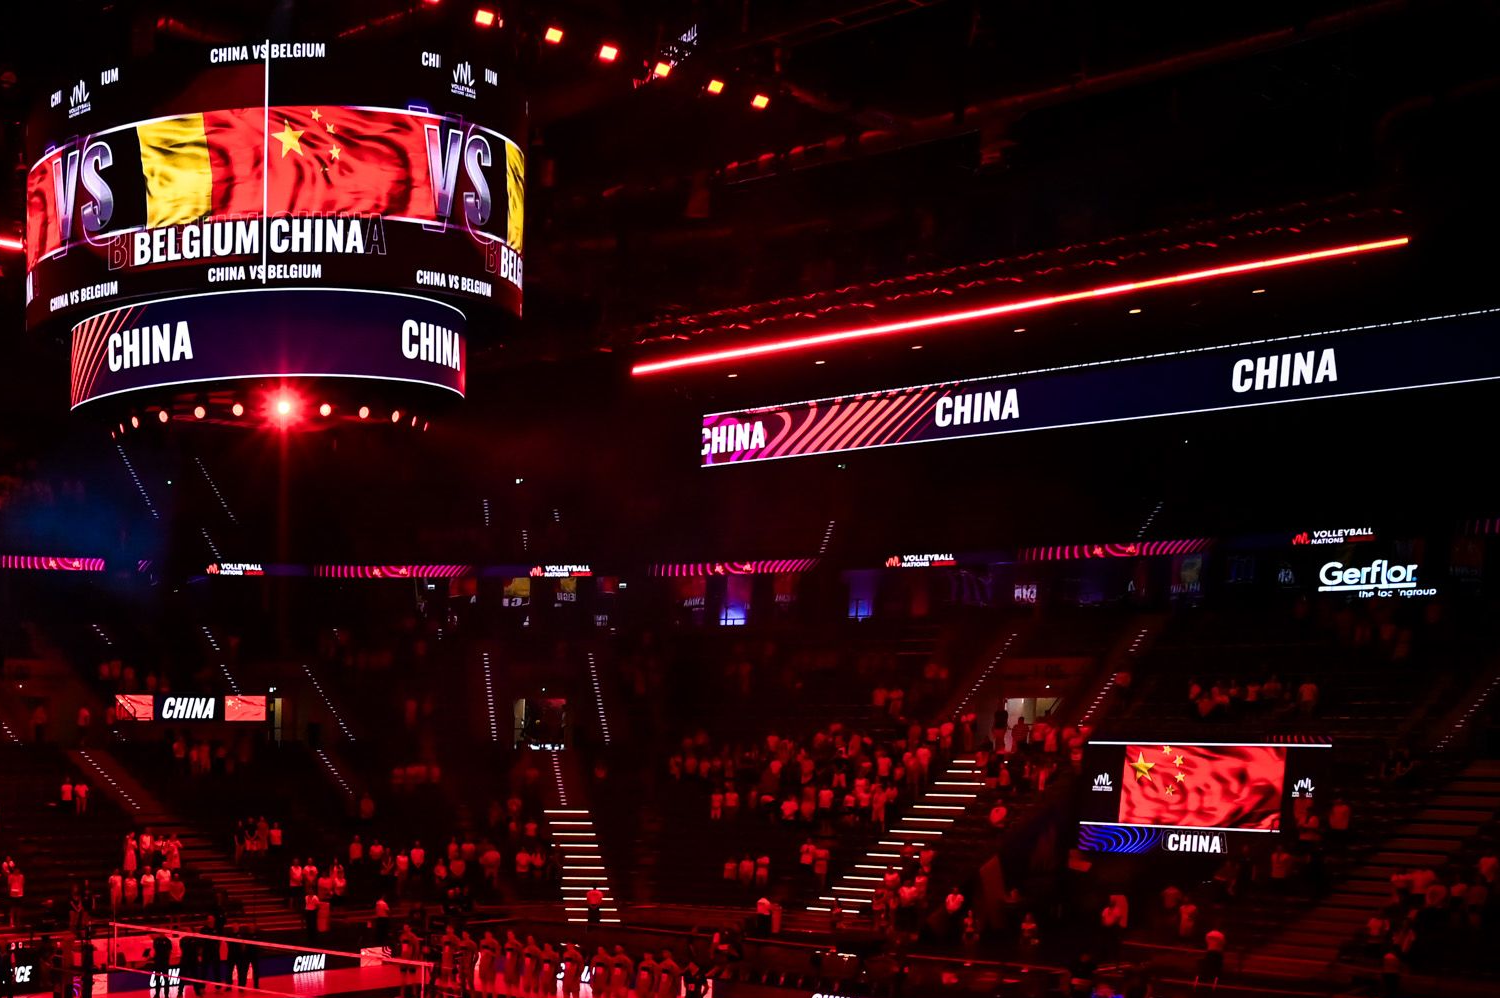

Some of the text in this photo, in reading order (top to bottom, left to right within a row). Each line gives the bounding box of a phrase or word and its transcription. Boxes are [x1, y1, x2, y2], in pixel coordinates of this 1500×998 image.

[209, 43, 326, 63] CHINA VS BELGIUM
[101, 67, 119, 86] IUM
[453, 61, 475, 87] VNL
[69, 79, 90, 107] VNL
[424, 124, 492, 226] VS
[52, 141, 114, 240] VS
[134, 218, 365, 266] BELGIUM CHINA
[208, 264, 322, 283] CHINA VS BELGIUM
[416, 270, 492, 298] CHINA VS BELGIUM
[50, 281, 118, 312] CHINA VS BELGIUM
[107, 320, 194, 373] CHINA
[402, 319, 461, 372] CHINA
[1232, 348, 1339, 394] CHINA
[935, 388, 1020, 428] CHINA
[1311, 537, 1345, 545] NATIONS
[1313, 527, 1374, 538] VOLLEYBALL
[220, 562, 263, 571] VOLLEYBALL
[903, 554, 954, 562] VOLLEYBALL
[161, 696, 216, 720] CHINA
[1168, 834, 1221, 853] CHINA
[293, 953, 326, 973] CHINA
